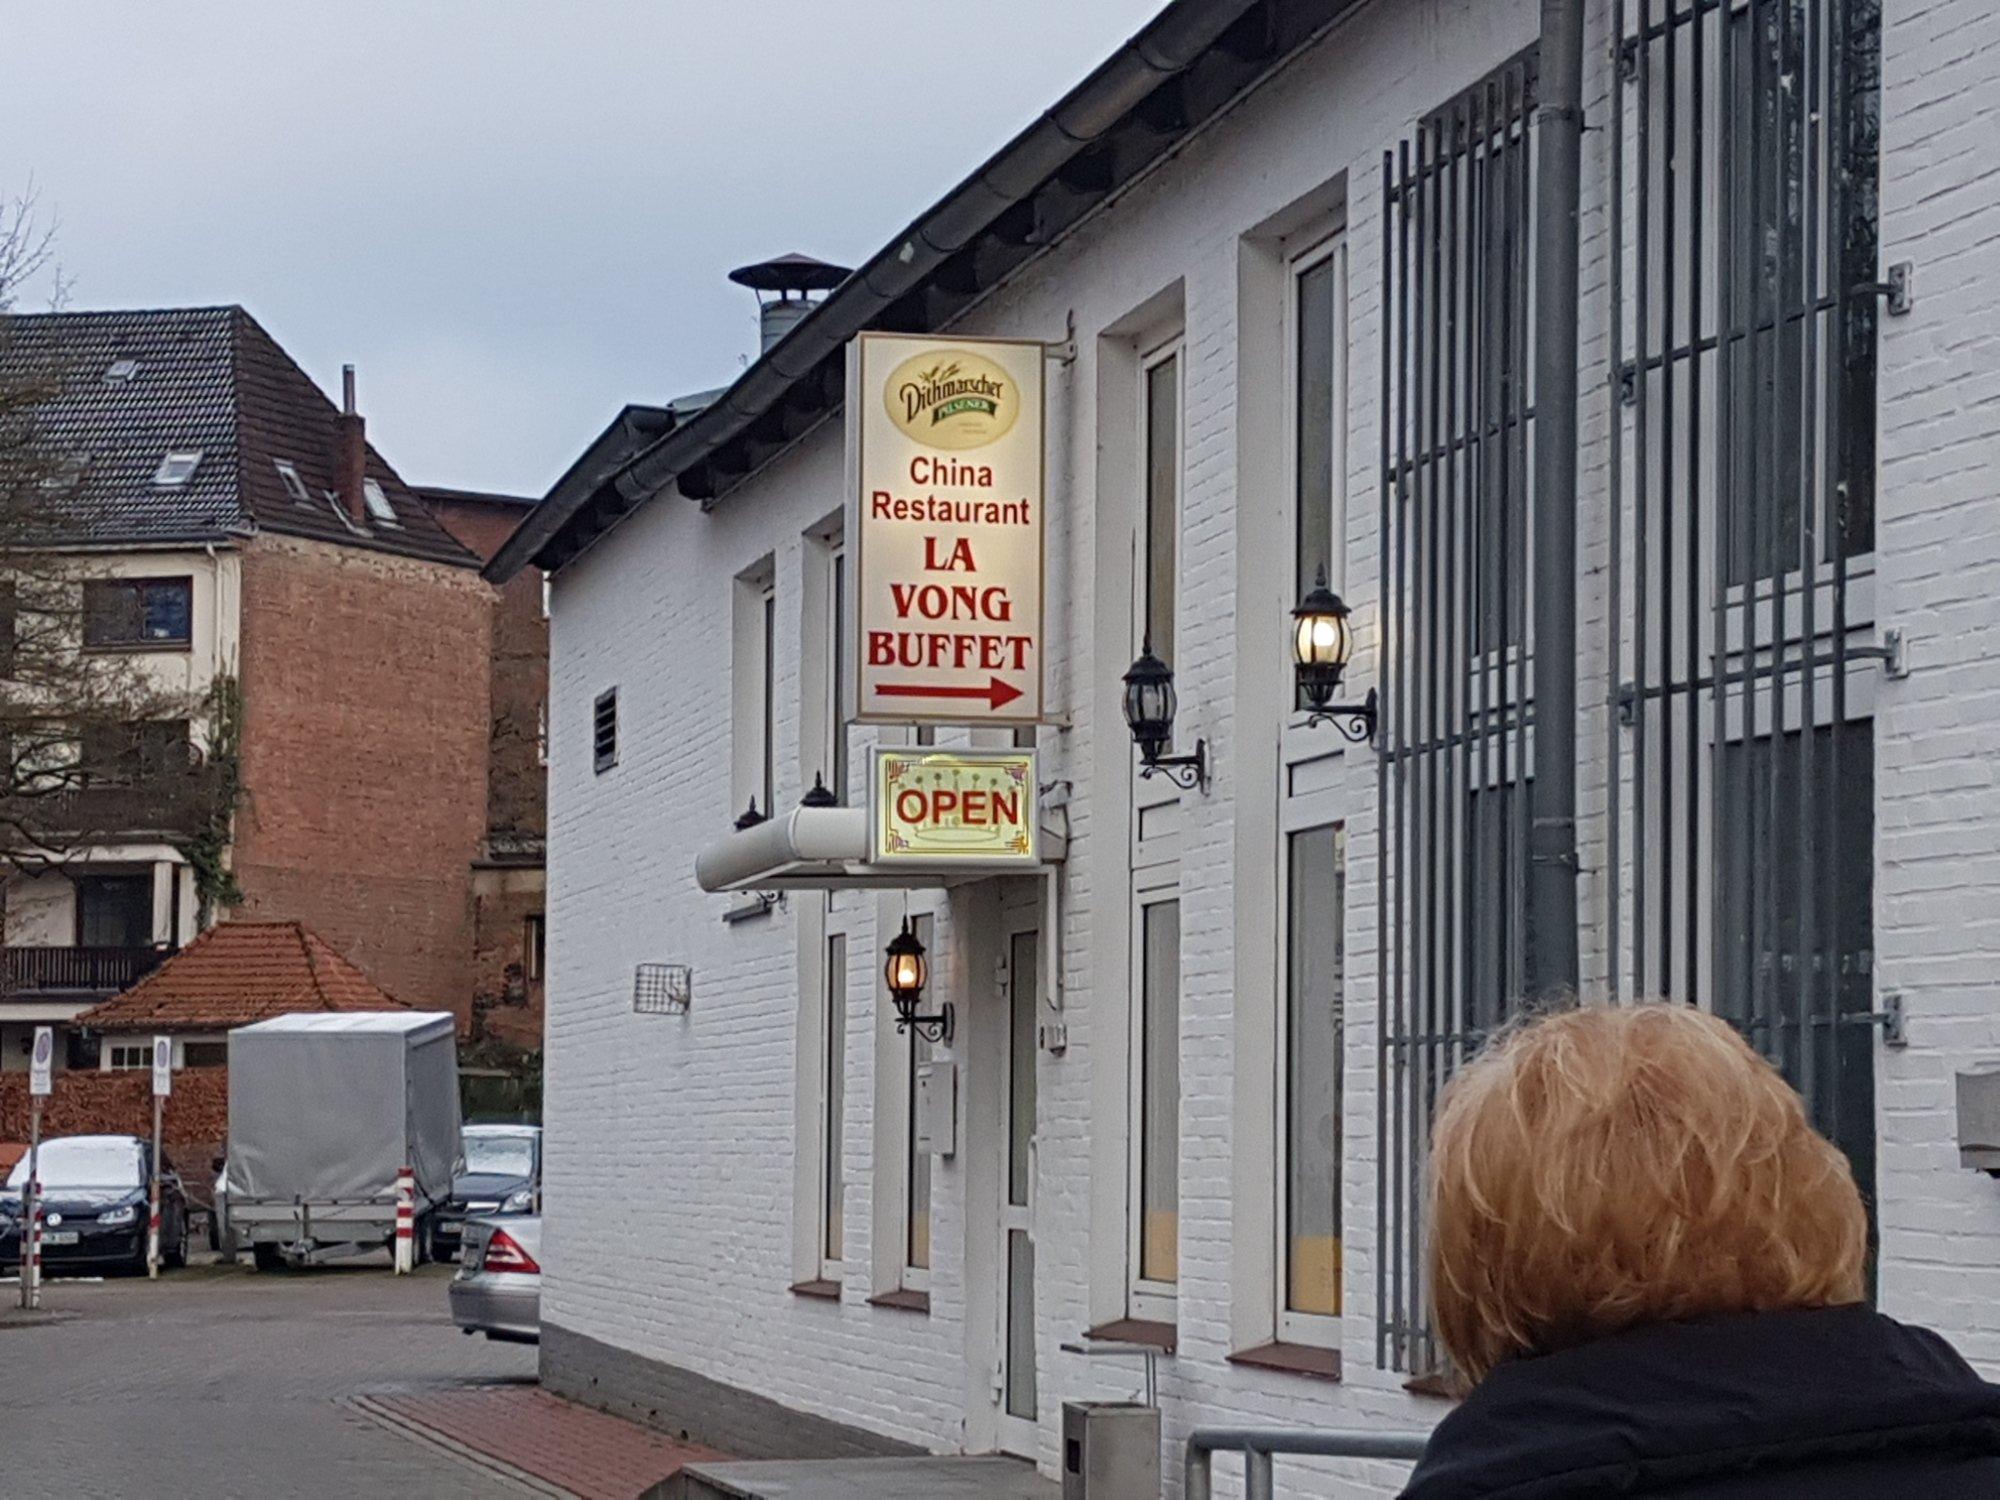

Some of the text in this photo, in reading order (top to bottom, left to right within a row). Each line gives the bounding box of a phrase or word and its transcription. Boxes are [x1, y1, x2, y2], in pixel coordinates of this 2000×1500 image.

[911, 456, 994, 487] China
[871, 490, 1030, 525] Restaurant
[924, 536, 977, 573] LA
[890, 583, 1012, 623] VONG
[867, 630, 1032, 671] BUFFET
[896, 788, 1018, 825] OPEN
